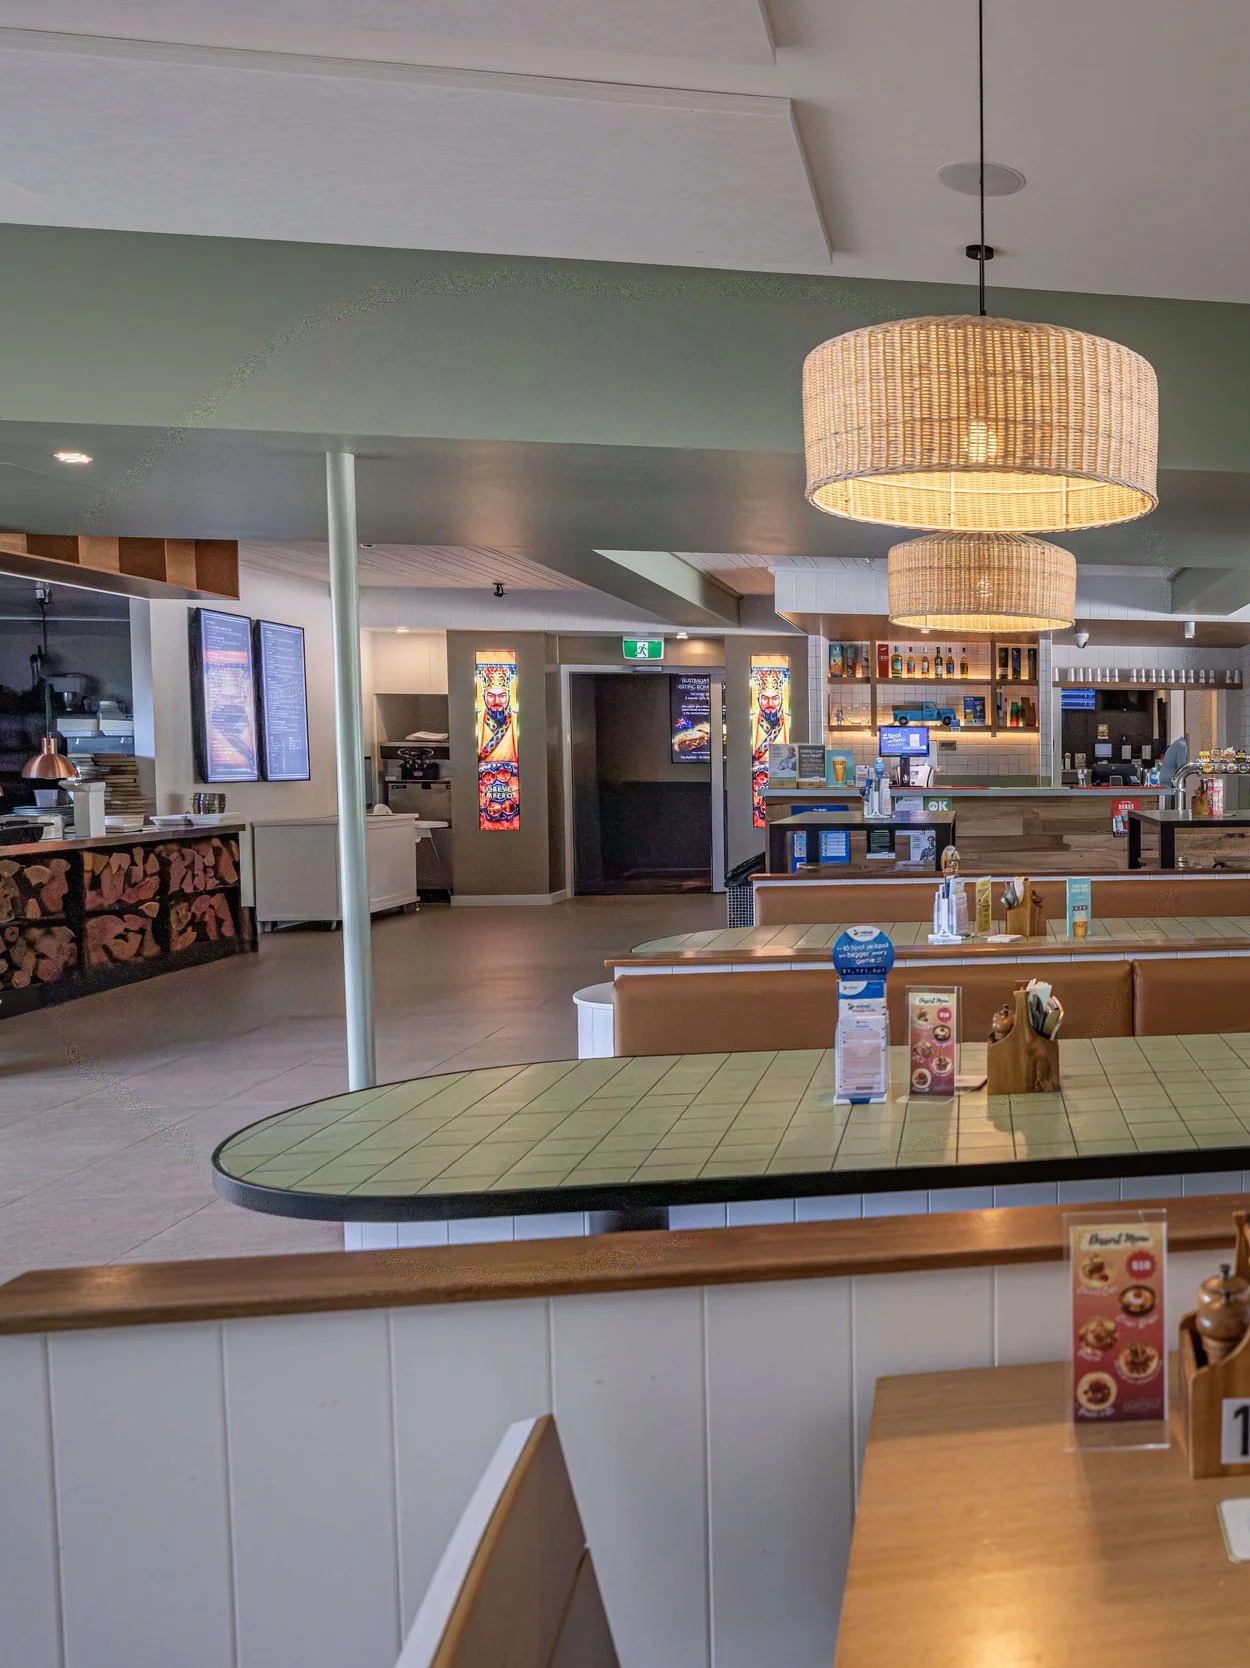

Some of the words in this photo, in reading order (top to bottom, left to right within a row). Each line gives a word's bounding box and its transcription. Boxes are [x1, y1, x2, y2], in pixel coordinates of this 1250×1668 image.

[928, 801, 948, 811] OK
[847, 951, 869, 959] bigger
[1088, 1231, 1122, 1246] Dessert
